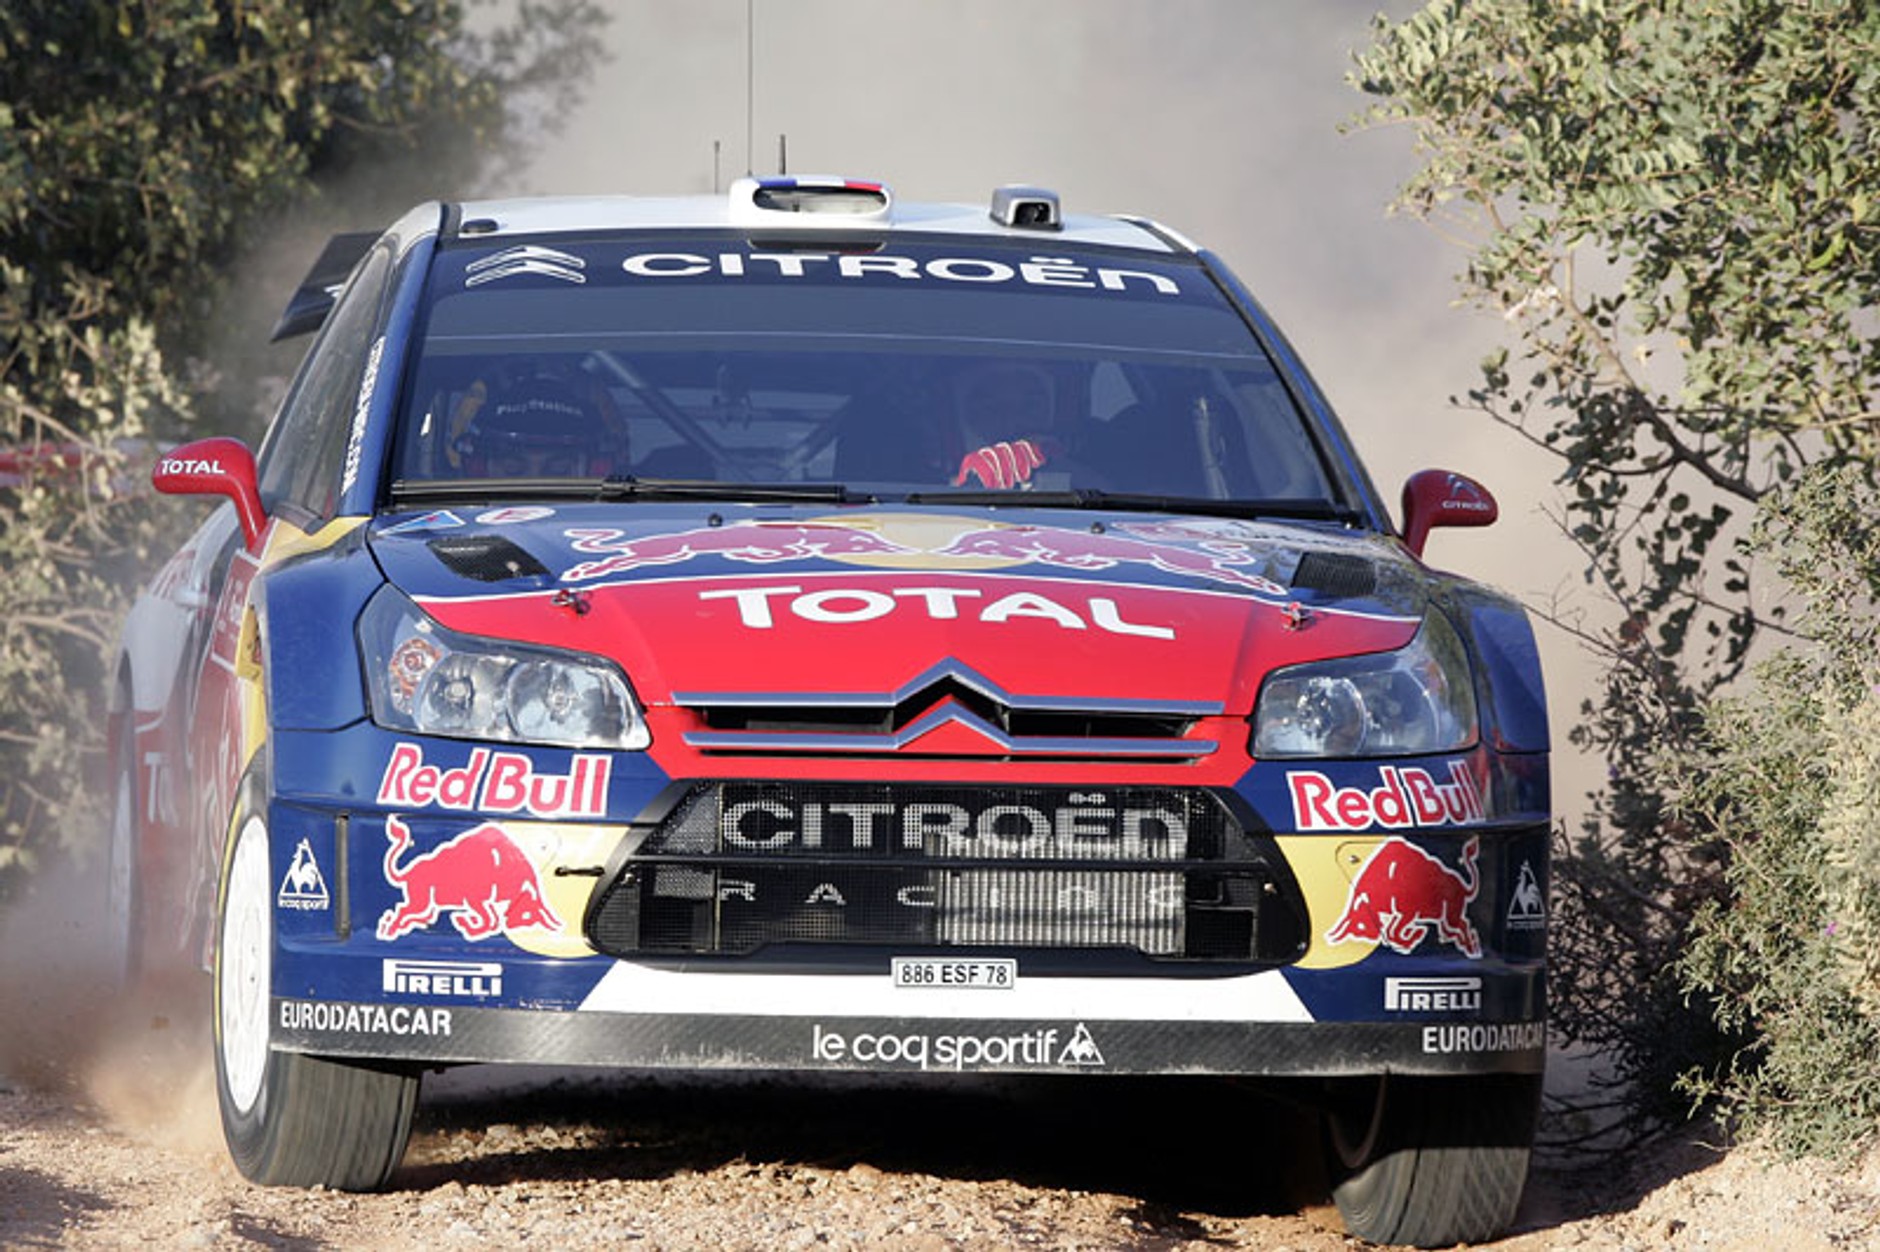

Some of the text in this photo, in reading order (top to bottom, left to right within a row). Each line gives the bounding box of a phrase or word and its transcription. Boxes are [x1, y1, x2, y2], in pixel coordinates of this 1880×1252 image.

[160, 459, 226, 475] TOTAL
[699, 586, 1176, 640] TOTAL
[377, 742, 612, 818] Red Bull
[1286, 760, 1486, 831] Red Bull
[382, 958, 502, 997] PIRELLI
[902, 965, 1008, 985] 886 ESF 78
[1384, 977, 1482, 1011] PIRELLI
[279, 1000, 452, 1036] EURODATACAR
[812, 1024, 1057, 1071] le coq sportif
